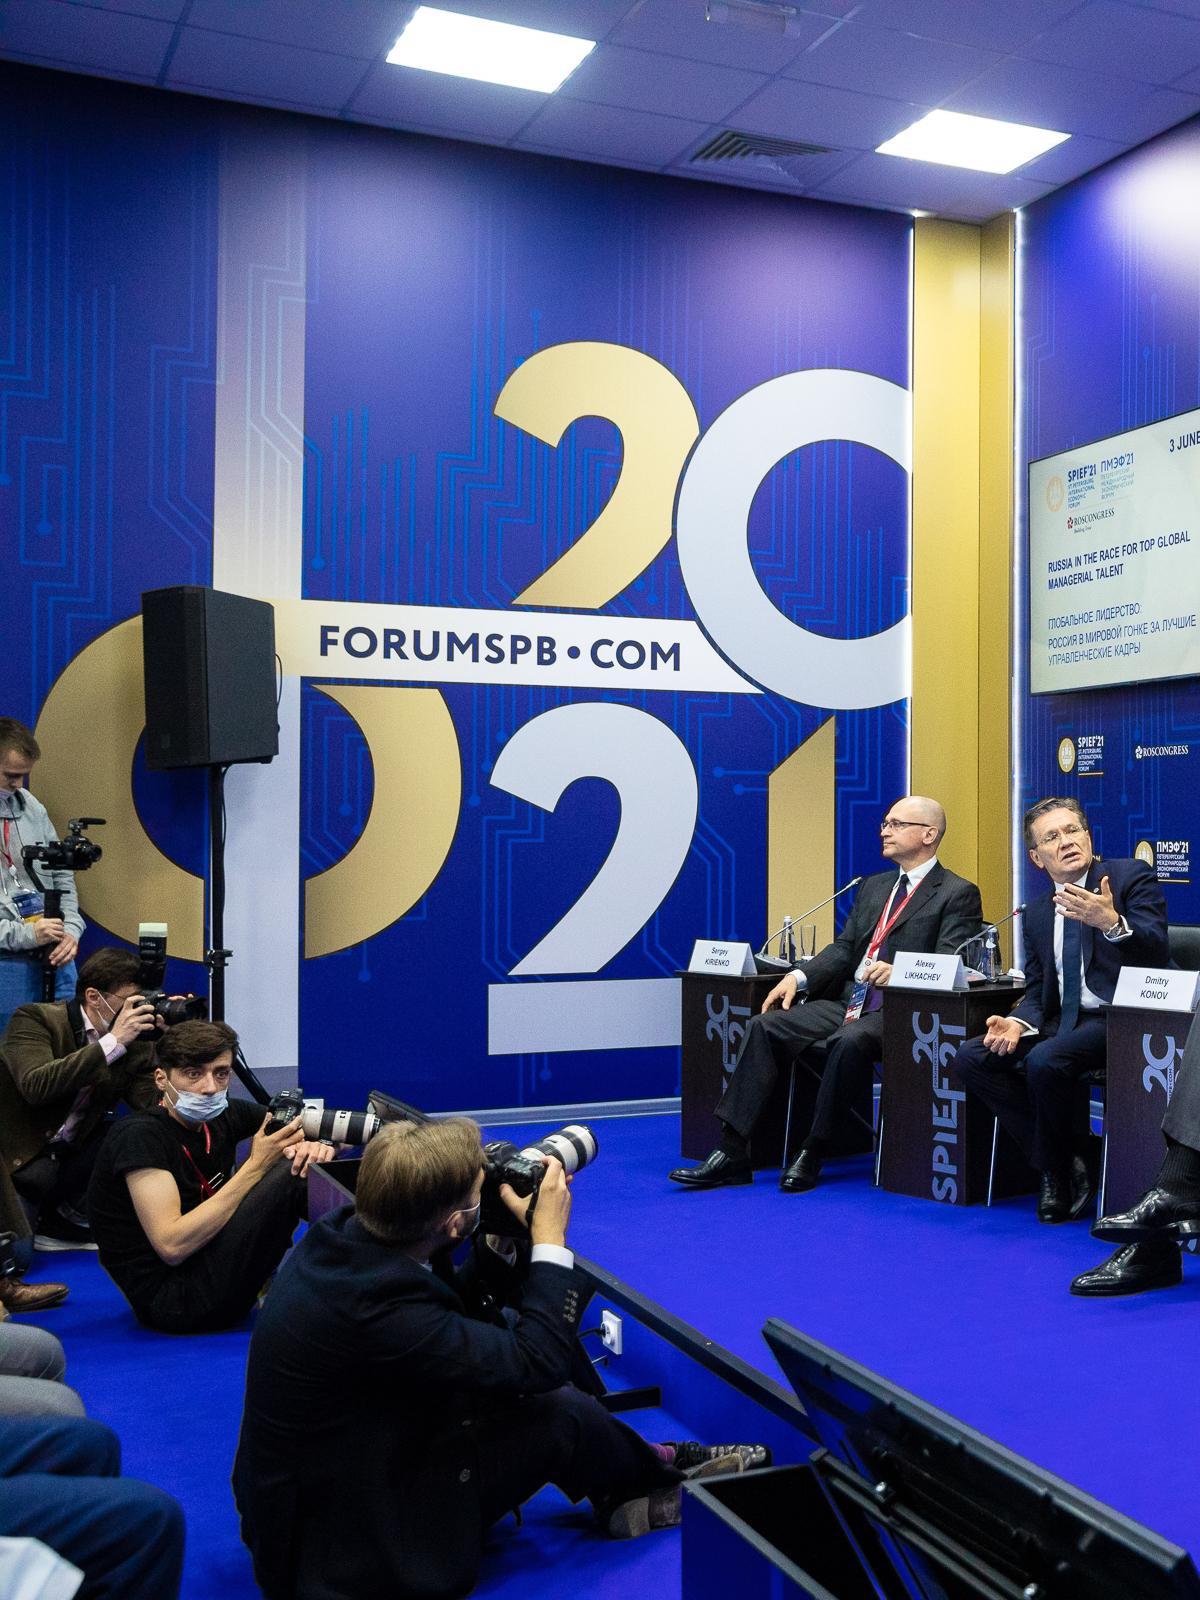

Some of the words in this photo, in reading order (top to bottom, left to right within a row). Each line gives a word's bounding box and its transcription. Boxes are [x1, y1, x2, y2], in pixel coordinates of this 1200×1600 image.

[1169, 439, 1175, 452] 3
[1048, 558, 1073, 573] RUSSIA
[1075, 556, 1082, 567] IN
[1084, 552, 1098, 565] THE
[1100, 546, 1120, 561] RACE
[1122, 542, 1138, 556] FOR
[1140, 538, 1155, 552] TOP
[1157, 530, 1191, 548] GLOBAL
[1048, 571, 1094, 590] MANAGERIAL
[1096, 563, 1124, 580] TALENT
[1048, 611, 1093, 630] ГЛОБАЛЬНОЕ
[1048, 634, 1078, 650] РОССИЯ
[1085, 625, 1122, 643] МИРОВОЙ
[1124, 622, 1148, 637] ГОНКЕ
[1150, 620, 1160, 633] ЗА
[1162, 614, 1197, 631] ЛУЧШИЕ
[1048, 646, 1113, 666] УПРАВЛЕНЧЕСКИЕ
[1115, 641, 1141, 656] КАДРЫ
[1143, 745, 1189, 757] ROSCONGRESS
[711, 947, 728, 957] Sergey
[704, 958, 730, 967] KIRIENKO
[915, 959, 936, 970] Alexey
[904, 971, 941, 981] LIKHACHEV
[1144, 975, 1169, 988] Dmitry
[1140, 989, 1168, 1000] KONOV
[932, 1077, 967, 1204] SPIEF
